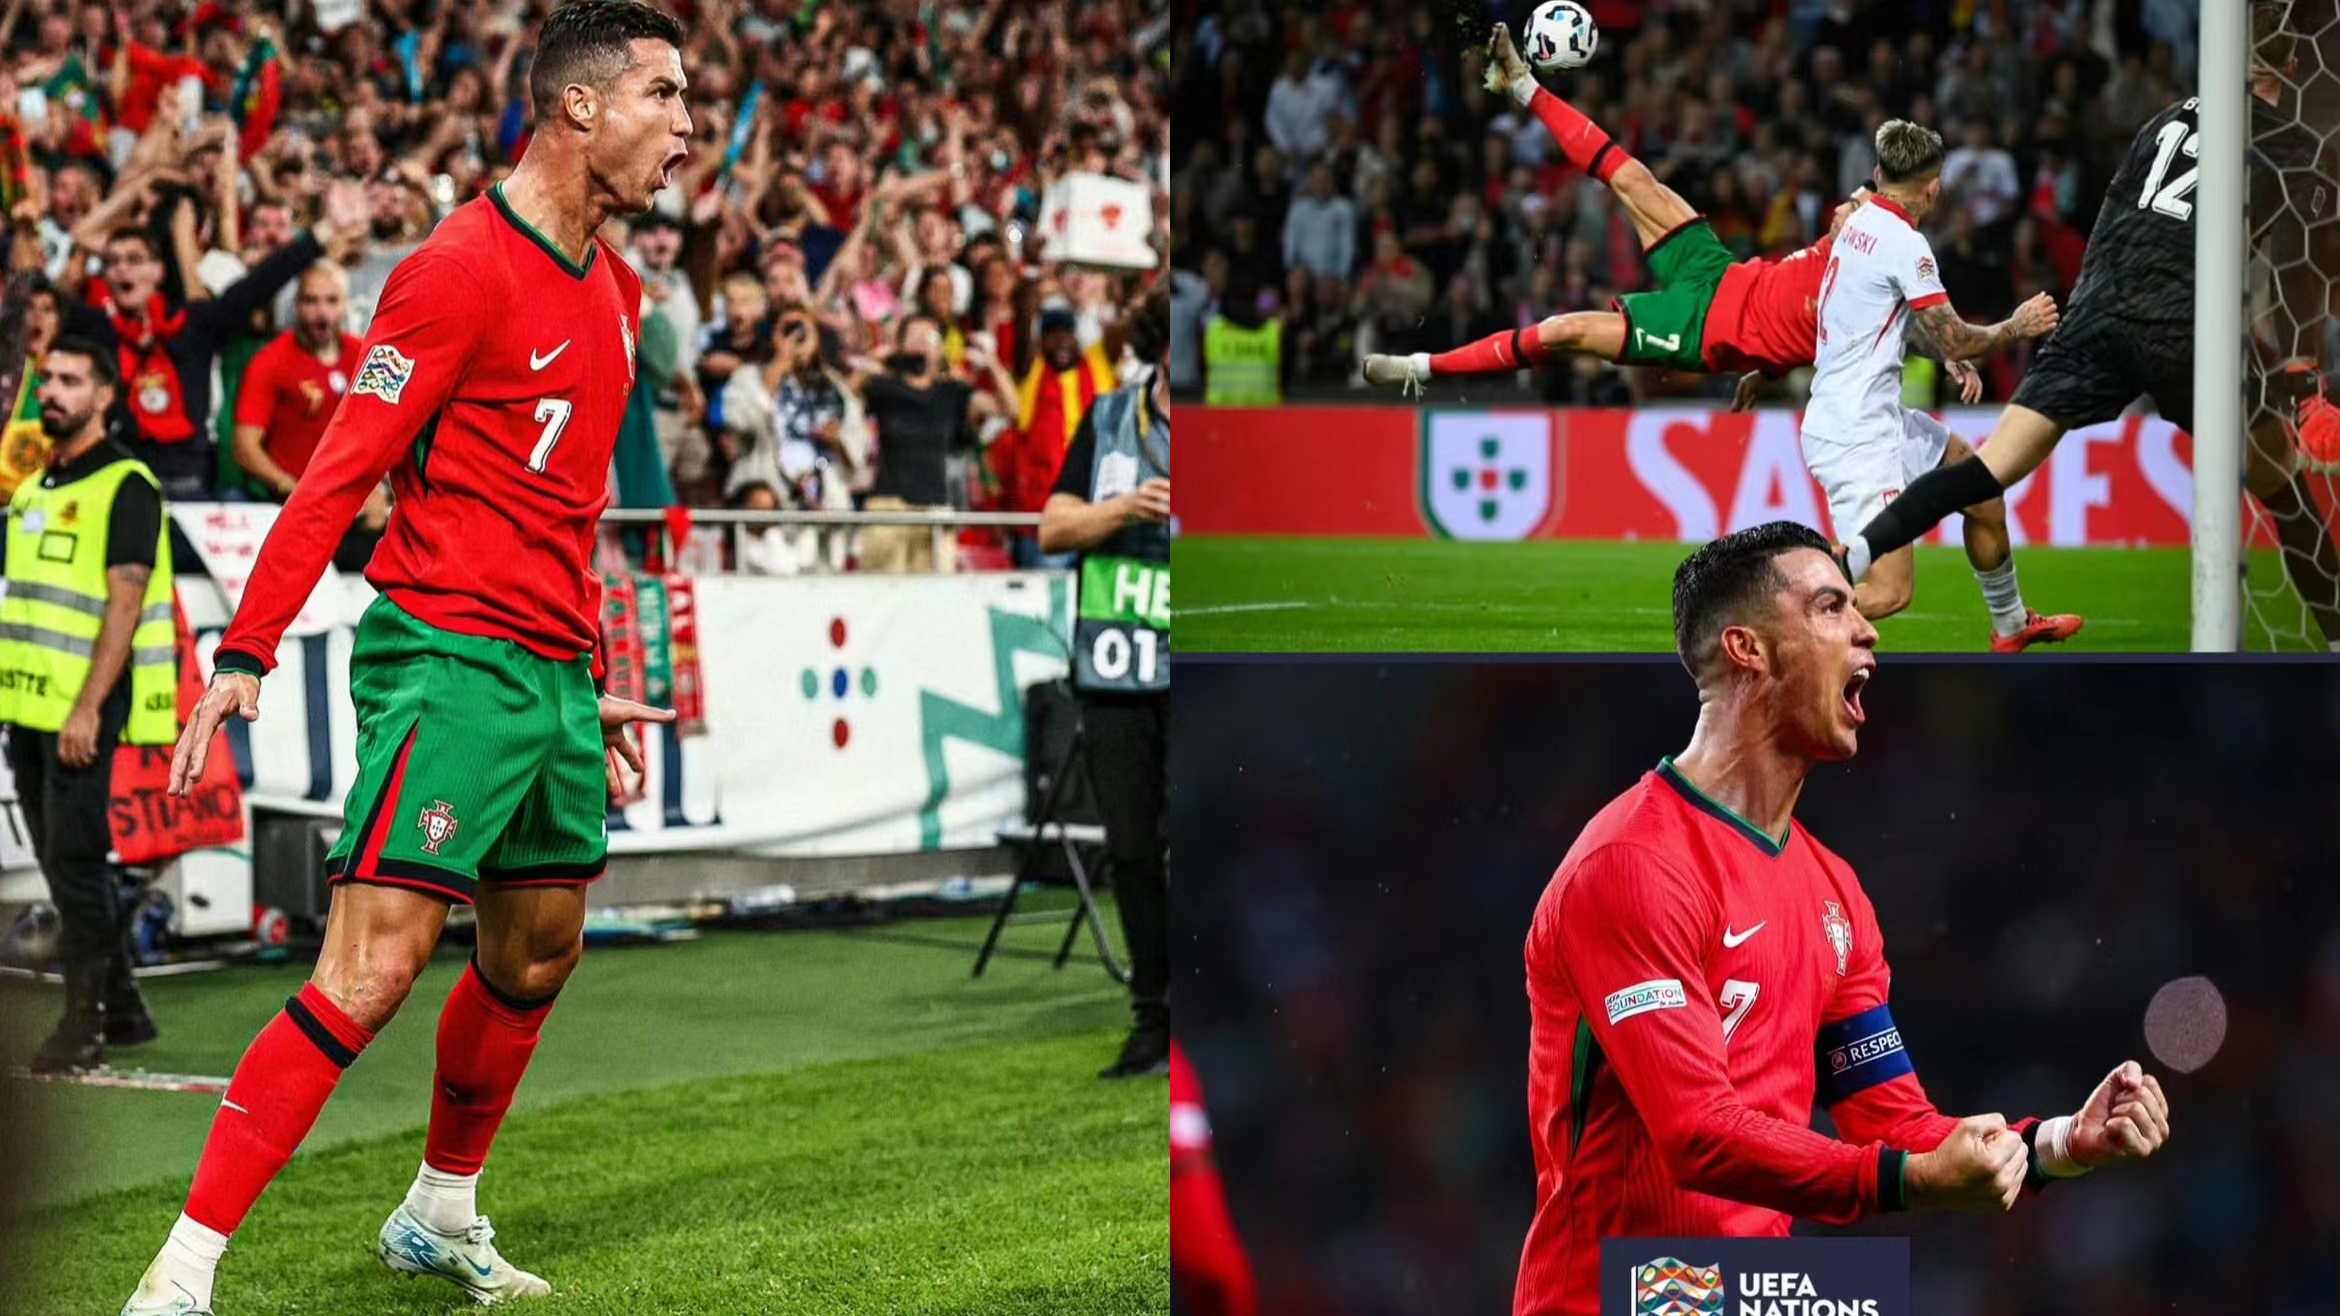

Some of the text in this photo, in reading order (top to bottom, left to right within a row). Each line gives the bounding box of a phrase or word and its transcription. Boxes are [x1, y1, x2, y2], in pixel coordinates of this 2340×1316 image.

[2138, 120, 2200, 222] 12
[1645, 333, 1680, 352] 7
[524, 397, 572, 473] 7
[1720, 979, 1760, 1046] 7
